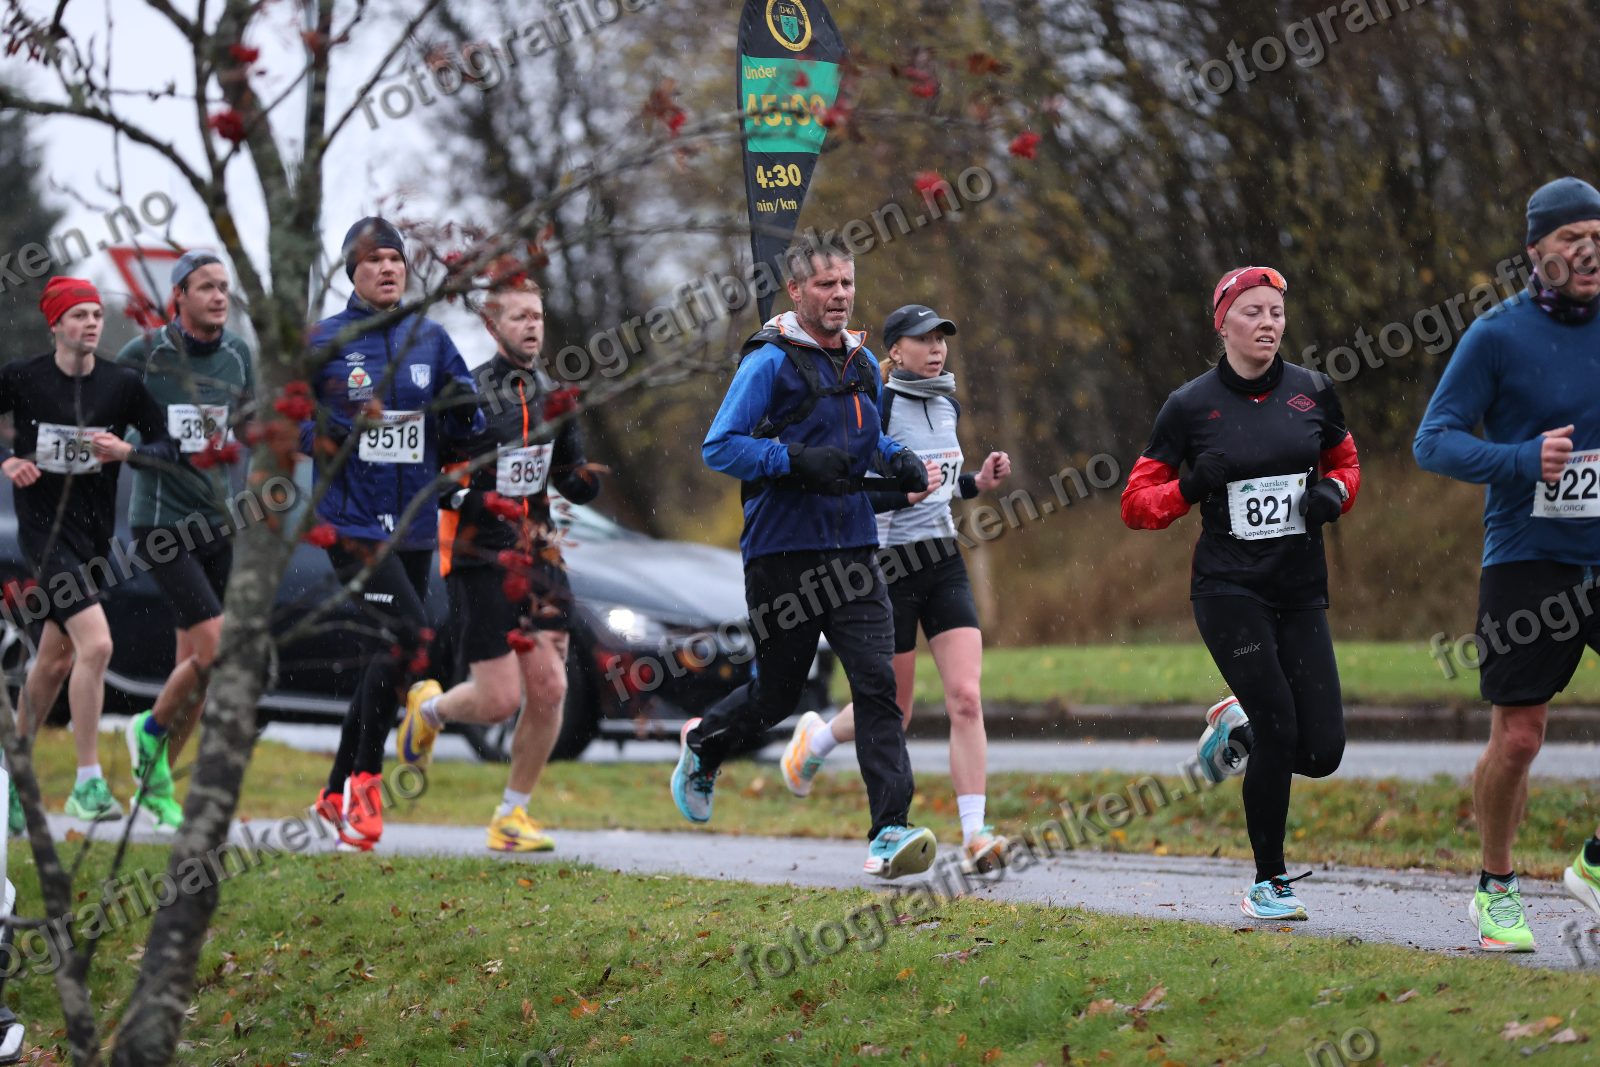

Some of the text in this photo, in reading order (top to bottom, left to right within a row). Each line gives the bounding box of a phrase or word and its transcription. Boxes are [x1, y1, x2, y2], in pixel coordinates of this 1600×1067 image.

[744, 65, 777, 80] Under
[756, 163, 802, 189] 4:30
[367, 425, 419, 449] 9518
[1259, 479, 1289, 489] Aurskog
[1246, 494, 1292, 527] 821
